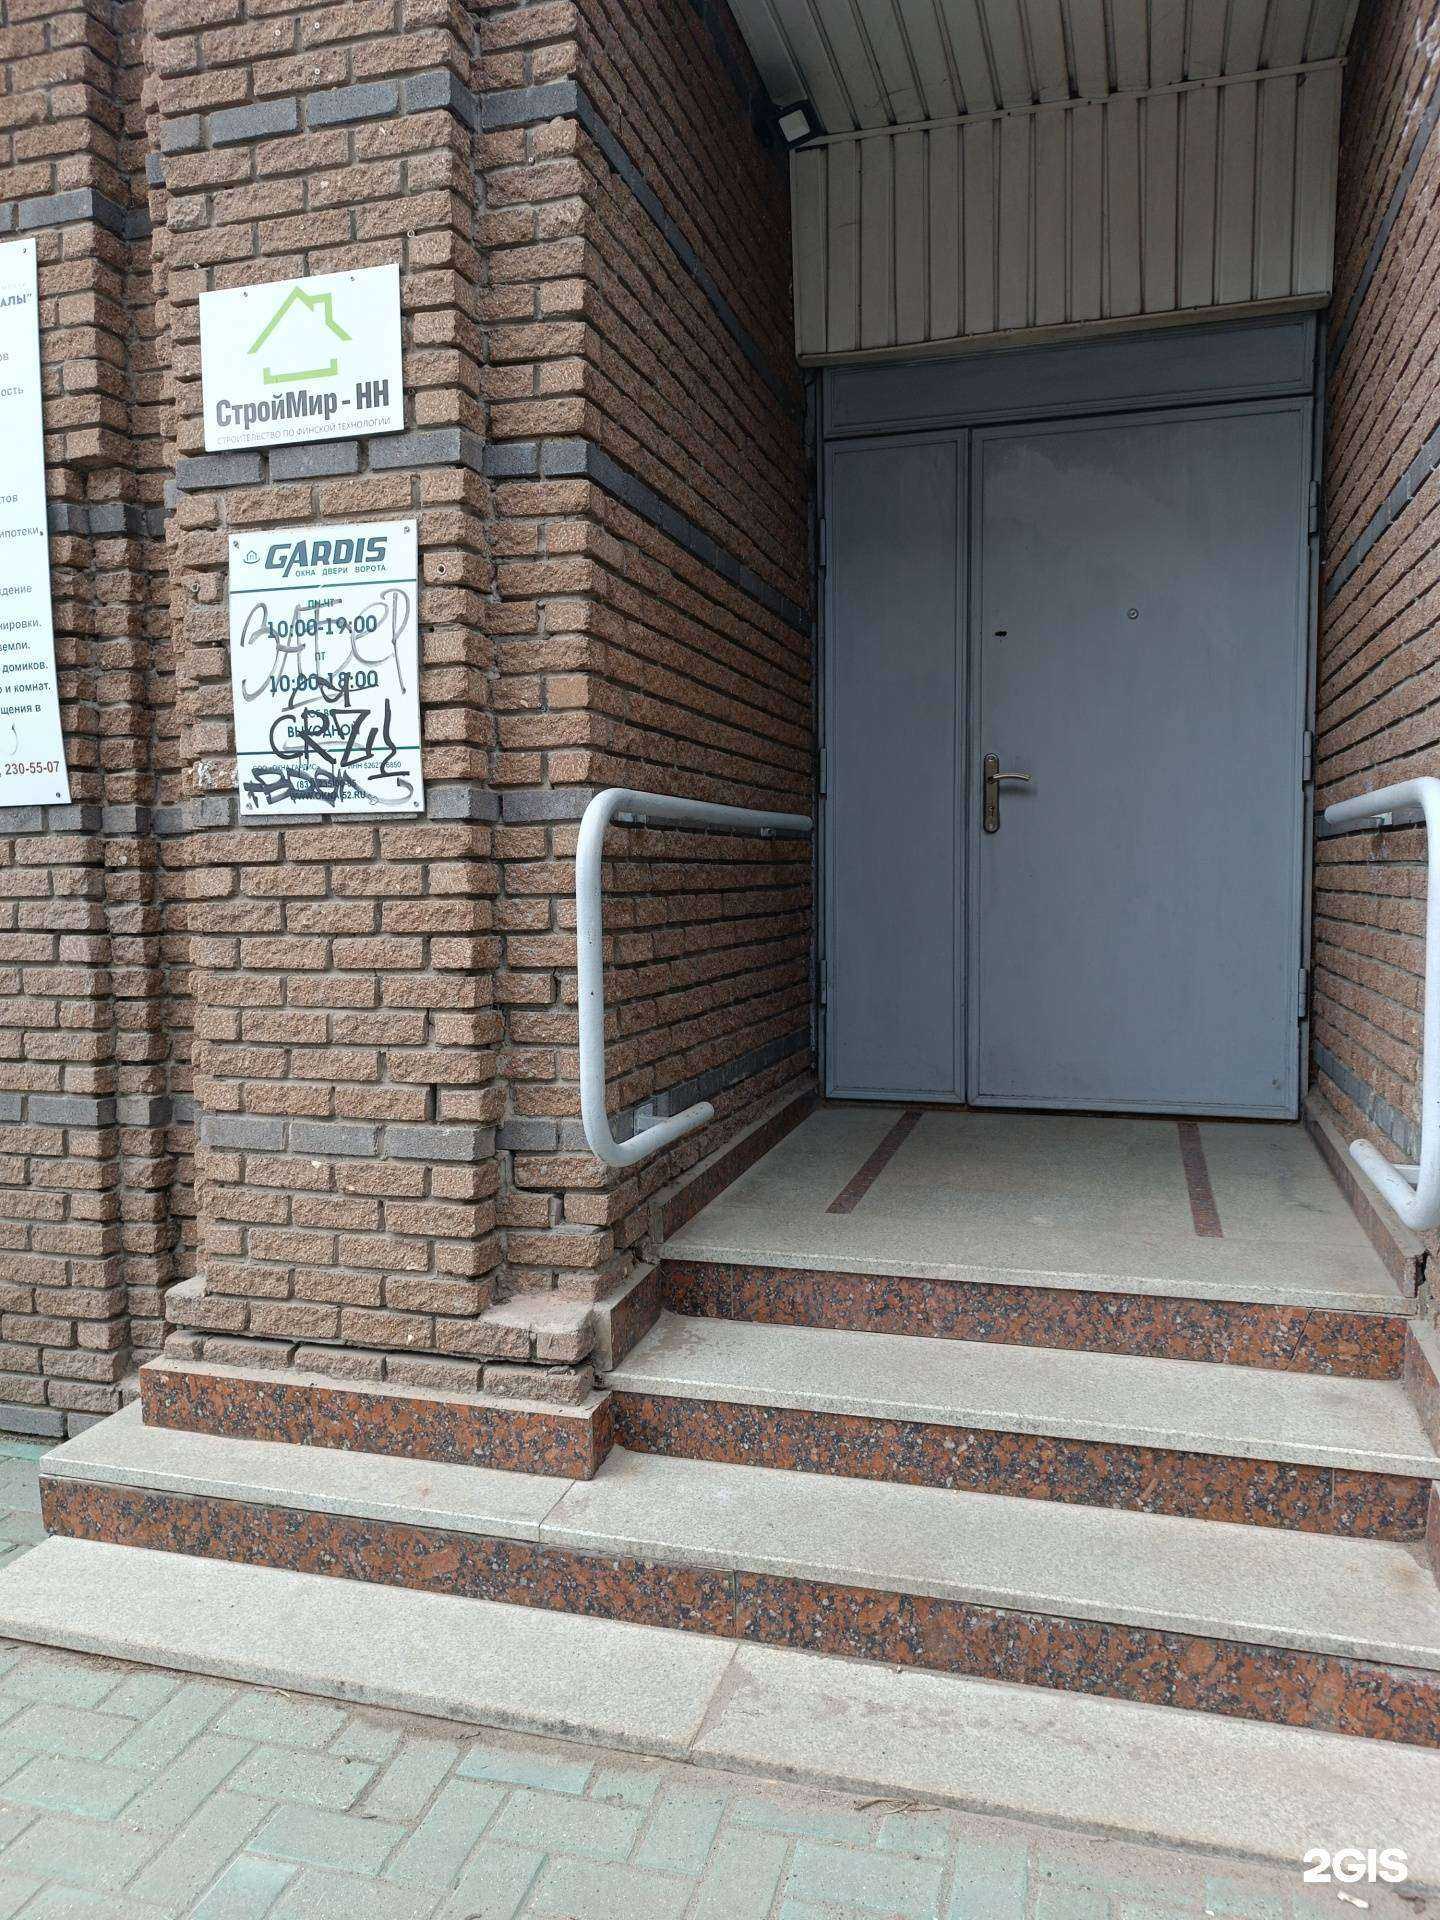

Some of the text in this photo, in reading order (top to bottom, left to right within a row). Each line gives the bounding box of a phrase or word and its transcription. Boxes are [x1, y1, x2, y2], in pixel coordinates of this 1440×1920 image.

[217, 416, 391, 445] СТРОИТЕЛЬСТВО ПО ФИНСКОЙ ТЕХНОЛОГИИ
[264, 536, 388, 578] GARDIS
[295, 565, 386, 577] ОКНА ДВЕРИ ВОРОТА
[268, 615, 378, 638] 10:00-19:00
[3, 661, 49, 674] домиков.
[14, 682, 51, 693] комнат.
[35, 704, 42, 713] в
[5, 761, 60, 775] 230-55-07
